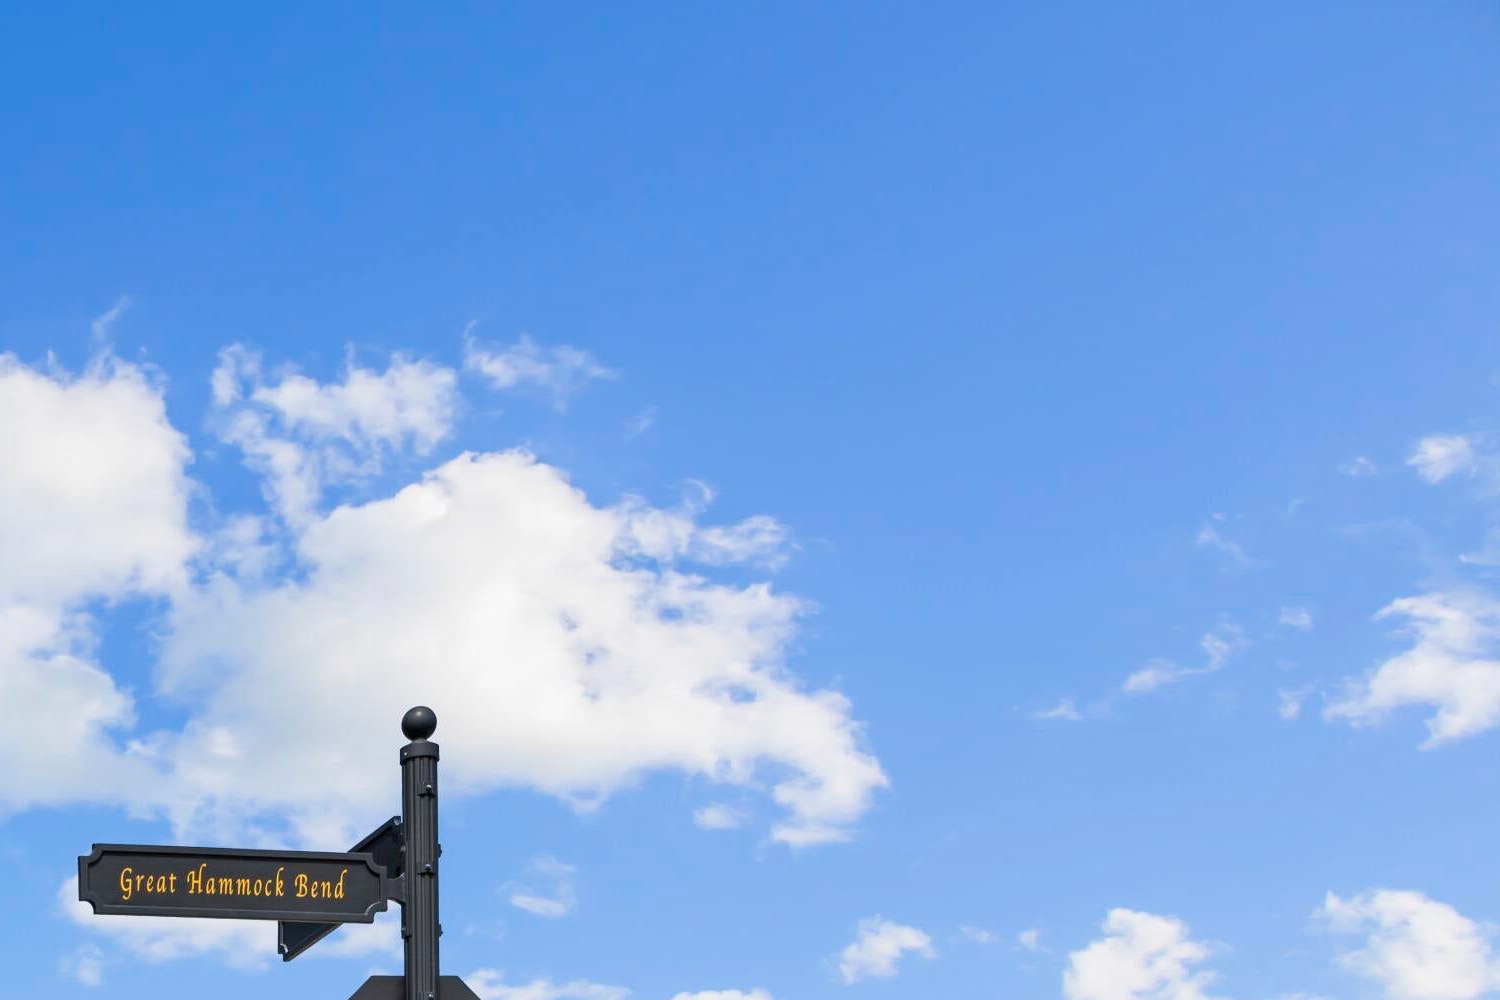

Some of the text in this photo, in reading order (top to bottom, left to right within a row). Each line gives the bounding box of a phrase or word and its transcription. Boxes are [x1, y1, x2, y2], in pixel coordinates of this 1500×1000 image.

[119, 863, 348, 900] Great Hammock Bend
